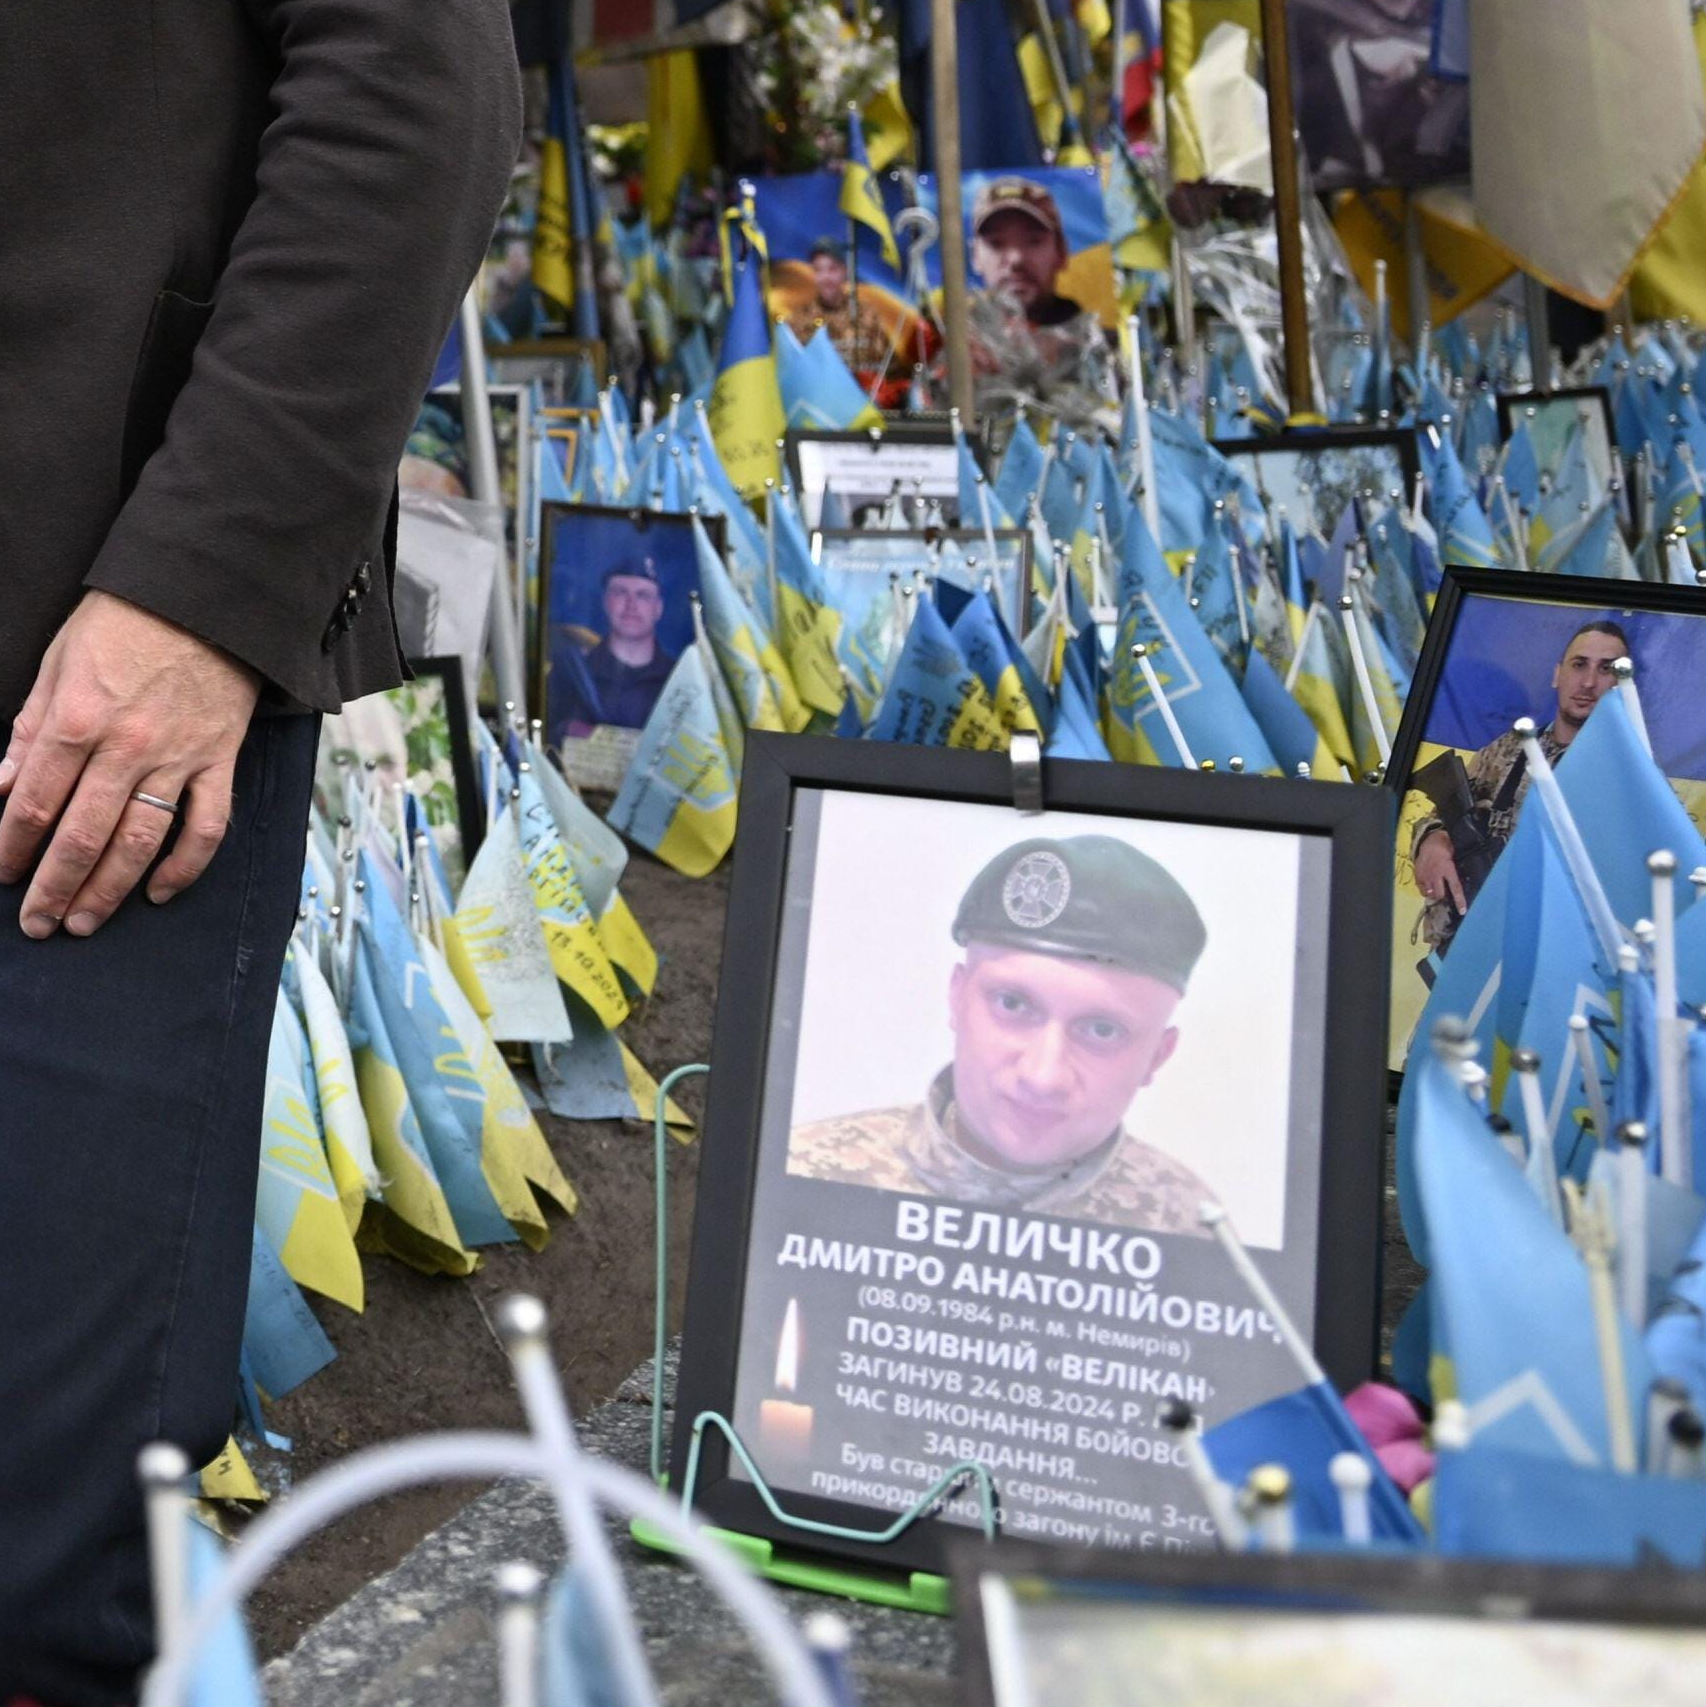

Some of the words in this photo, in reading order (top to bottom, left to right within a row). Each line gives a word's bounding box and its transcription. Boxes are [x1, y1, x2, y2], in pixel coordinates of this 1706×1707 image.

[896, 1200, 1163, 1279] ВЕЛИЧКО
[777, 1233, 945, 1287] ДМИТРО
[952, 1261, 1285, 1345] АНАТОЛІЙОВИЧ
[858, 1285, 994, 1325] (08.09.1984
[998, 1310, 1040, 1334] р.н.
[1045, 1320, 1072, 1339] м.
[1077, 1322, 1191, 1363] Немирів)
[847, 1316, 1038, 1373] ПОЗИВНИЙ
[836, 1382, 888, 1413] ЧАС
[893, 1392, 1070, 1447] ВИКОНАННЯ
[1076, 1427, 1190, 1469] БОЙОВО
[837, 1351, 964, 1394] ЗАГИНУВ
[969, 1374, 1116, 1421] 24.08.2024
[1122, 1401, 1146, 1428] Р.
[841, 1441, 884, 1473] Був
[1006, 1478, 1153, 1524] сержантом
[923, 1430, 1098, 1486] ЗАВДАННЯ...
[1013, 1511, 1101, 1545] загону
